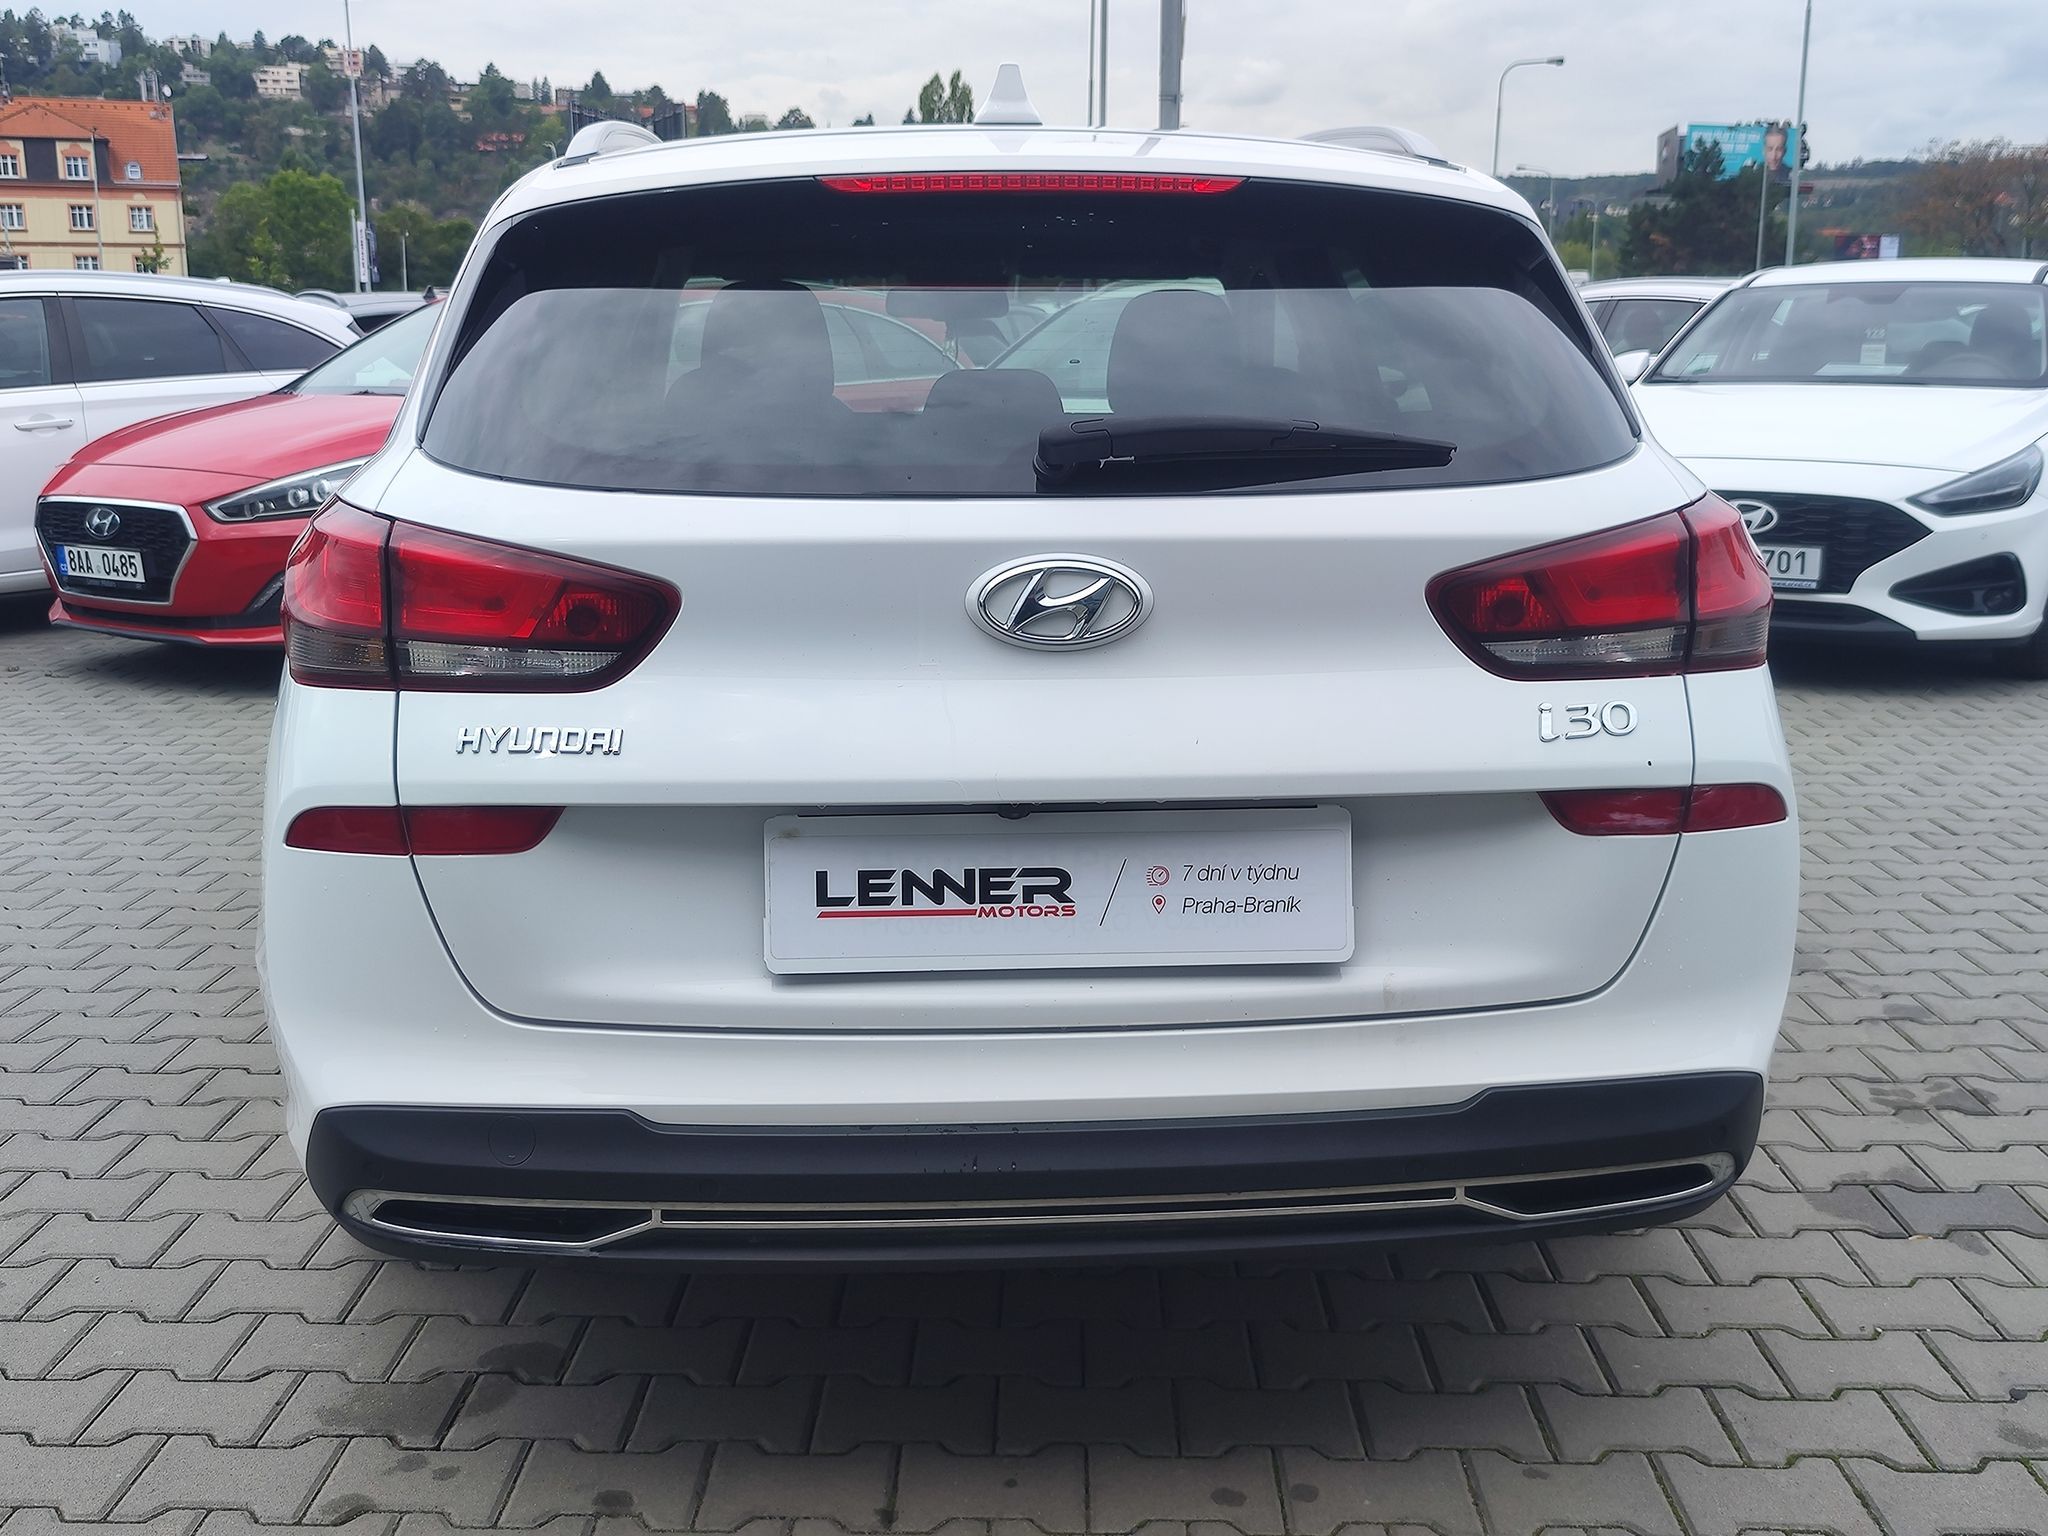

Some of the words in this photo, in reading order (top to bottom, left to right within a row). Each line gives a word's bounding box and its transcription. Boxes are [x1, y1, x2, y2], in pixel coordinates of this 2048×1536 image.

[68, 550, 94, 574] 8AA
[102, 553, 138, 578] 0485
[1538, 700, 1639, 743] i30
[456, 726, 624, 755] HYUNDAI
[815, 867, 1076, 907] LENNER
[1183, 864, 1194, 881] 7
[1197, 864, 1228, 881] dní
[1231, 867, 1242, 881] v
[1247, 863, 1300, 885] týdnu
[977, 905, 1076, 918] MOTORS
[1182, 896, 1302, 914] Praha-Braník
